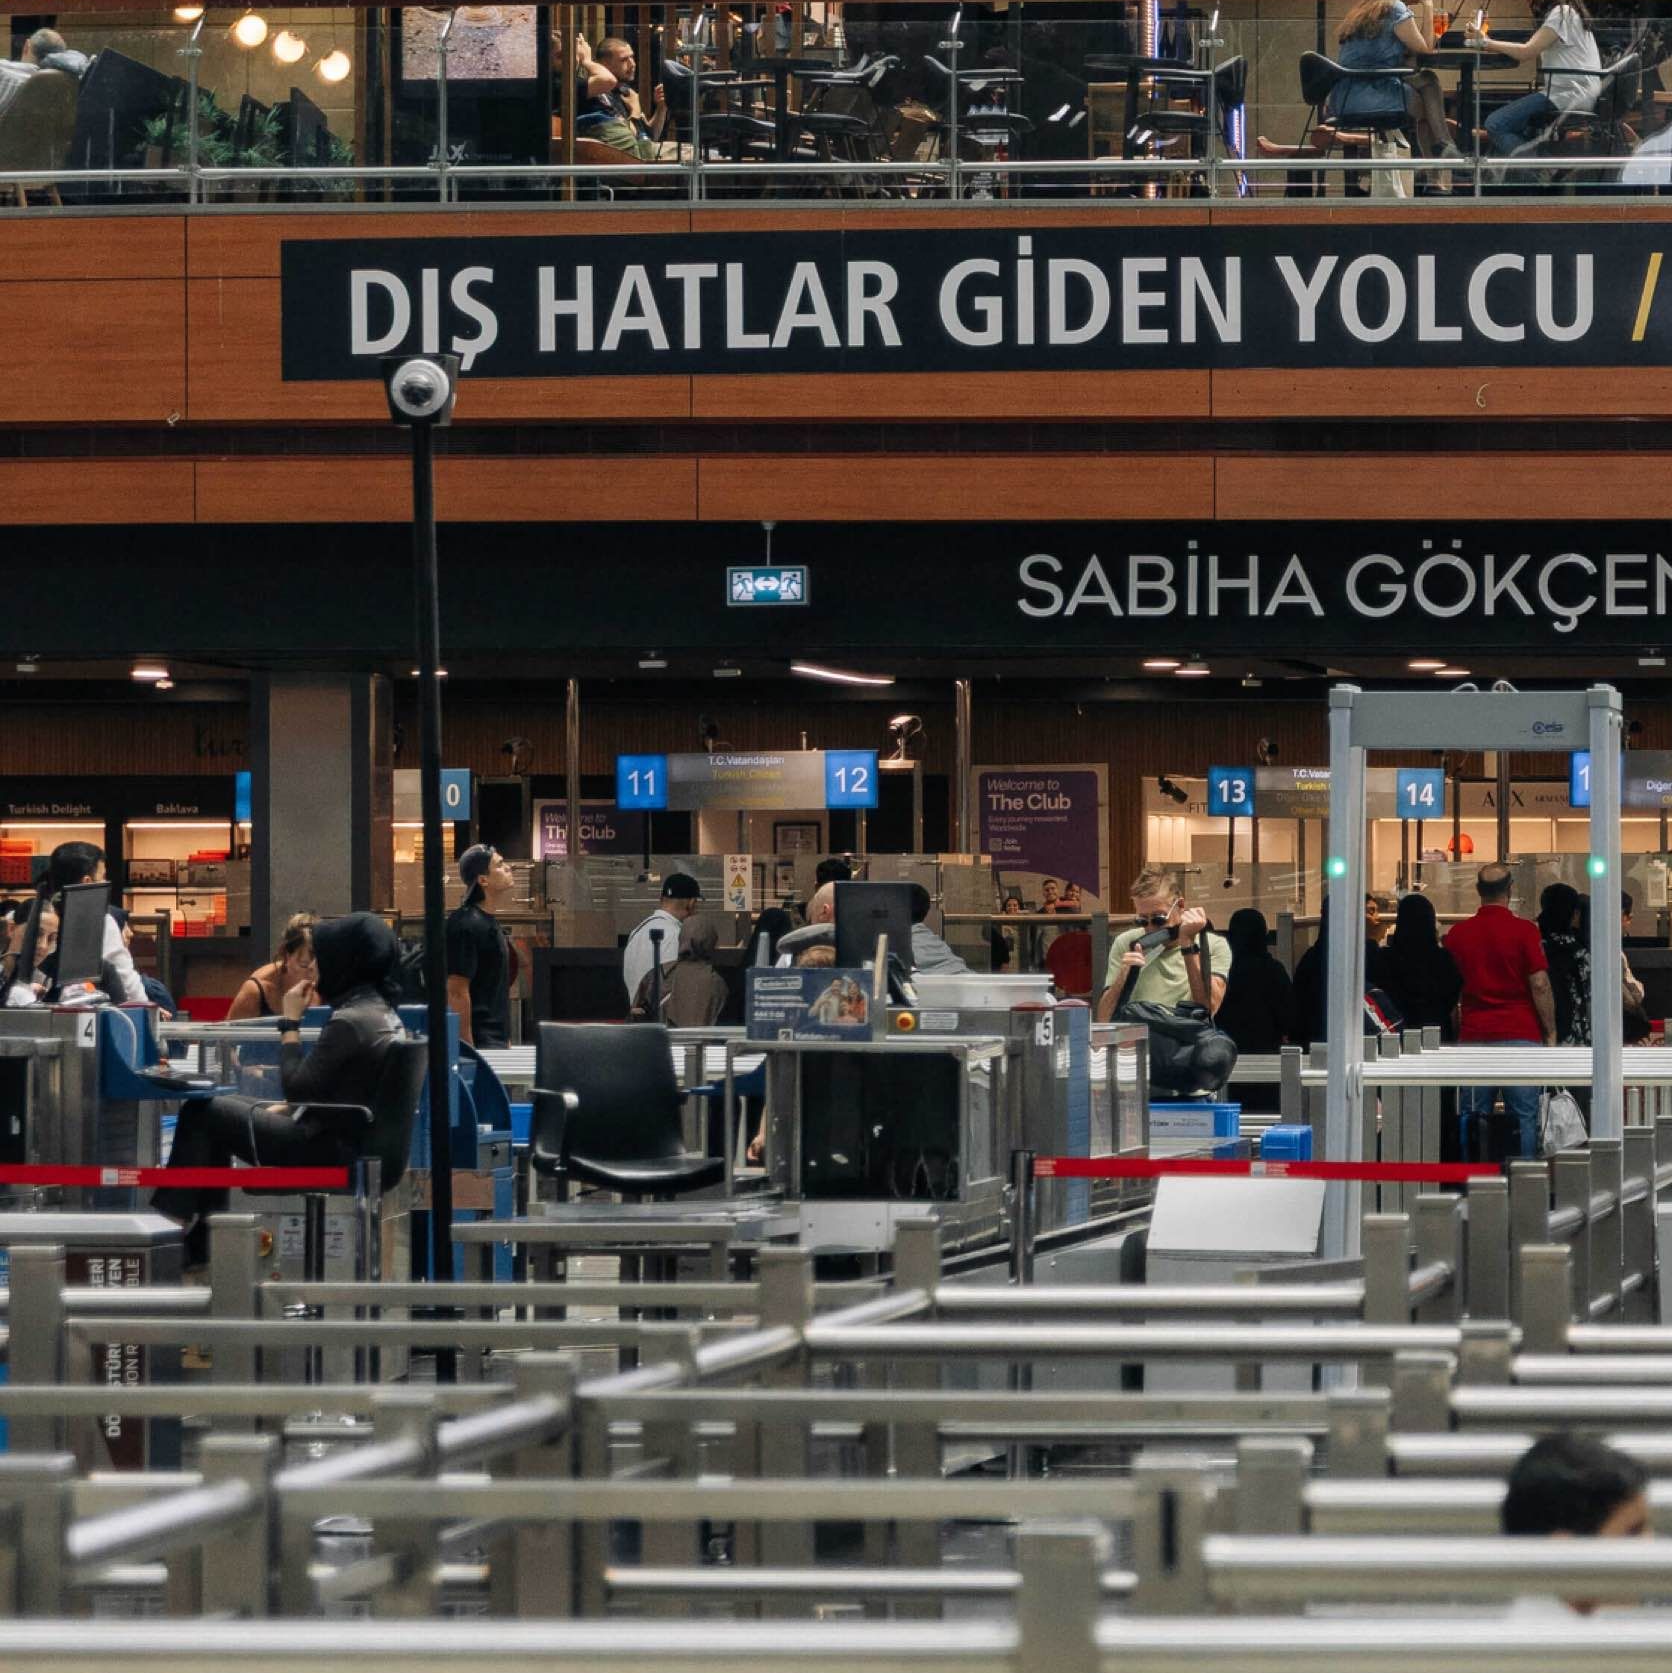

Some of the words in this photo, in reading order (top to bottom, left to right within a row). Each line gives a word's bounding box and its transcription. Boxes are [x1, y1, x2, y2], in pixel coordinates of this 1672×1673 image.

[350, 266, 498, 371] DIŞ
[538, 261, 903, 352] HATLAR
[938, 235, 1242, 346] GİDEN
[1274, 253, 1594, 343] YOLCU
[1631, 252, 1664, 342] /
[1017, 540, 1325, 618] SABİHA
[627, 770, 656, 796] 11
[834, 767, 869, 793] 12
[987, 778, 1045, 792] Welcome
[1578, 765, 1590, 792] 1
[445, 782, 461, 808] 0
[986, 793, 1025, 811] The
[1027, 792, 1072, 811] Club
[1218, 779, 1246, 804] 13
[1406, 782, 1435, 806] 14
[8, 804, 49, 815] Turkish
[51, 804, 92, 817] Delight
[156, 804, 200, 815] Baklava
[84, 1017, 95, 1042] 4
[1043, 1015, 1051, 1041] 5
